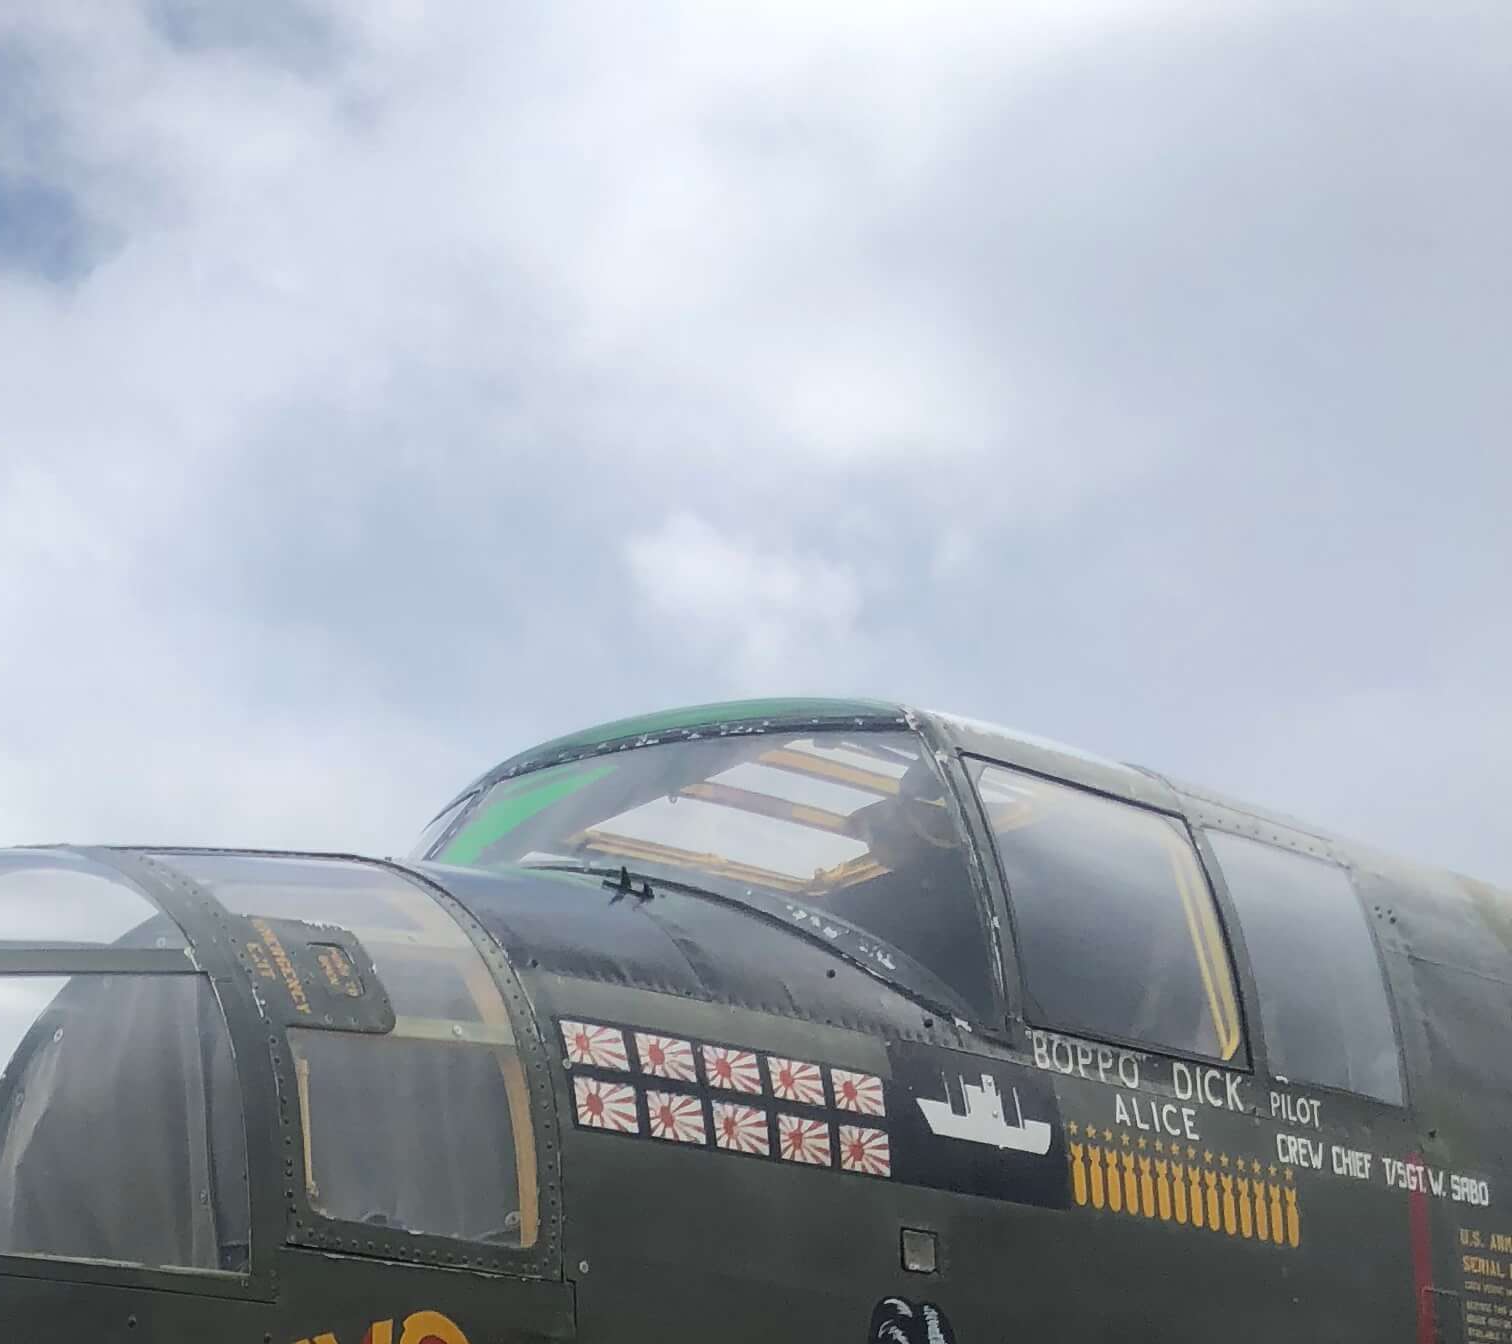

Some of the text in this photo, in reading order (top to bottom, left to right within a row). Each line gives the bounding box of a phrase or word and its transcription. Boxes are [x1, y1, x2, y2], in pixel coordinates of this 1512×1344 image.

[1172, 1062, 1245, 1112] DICK
[1269, 1090, 1322, 1128] PILOT
[1115, 1093, 1201, 1141] ALICE
[1276, 1133, 1324, 1170] CREW
[1331, 1145, 1373, 1180] CHIEF
[1428, 1167, 1448, 1198] W.
[1450, 1174, 1490, 1207] SABO
[1489, 1233, 1512, 1254] ARM
